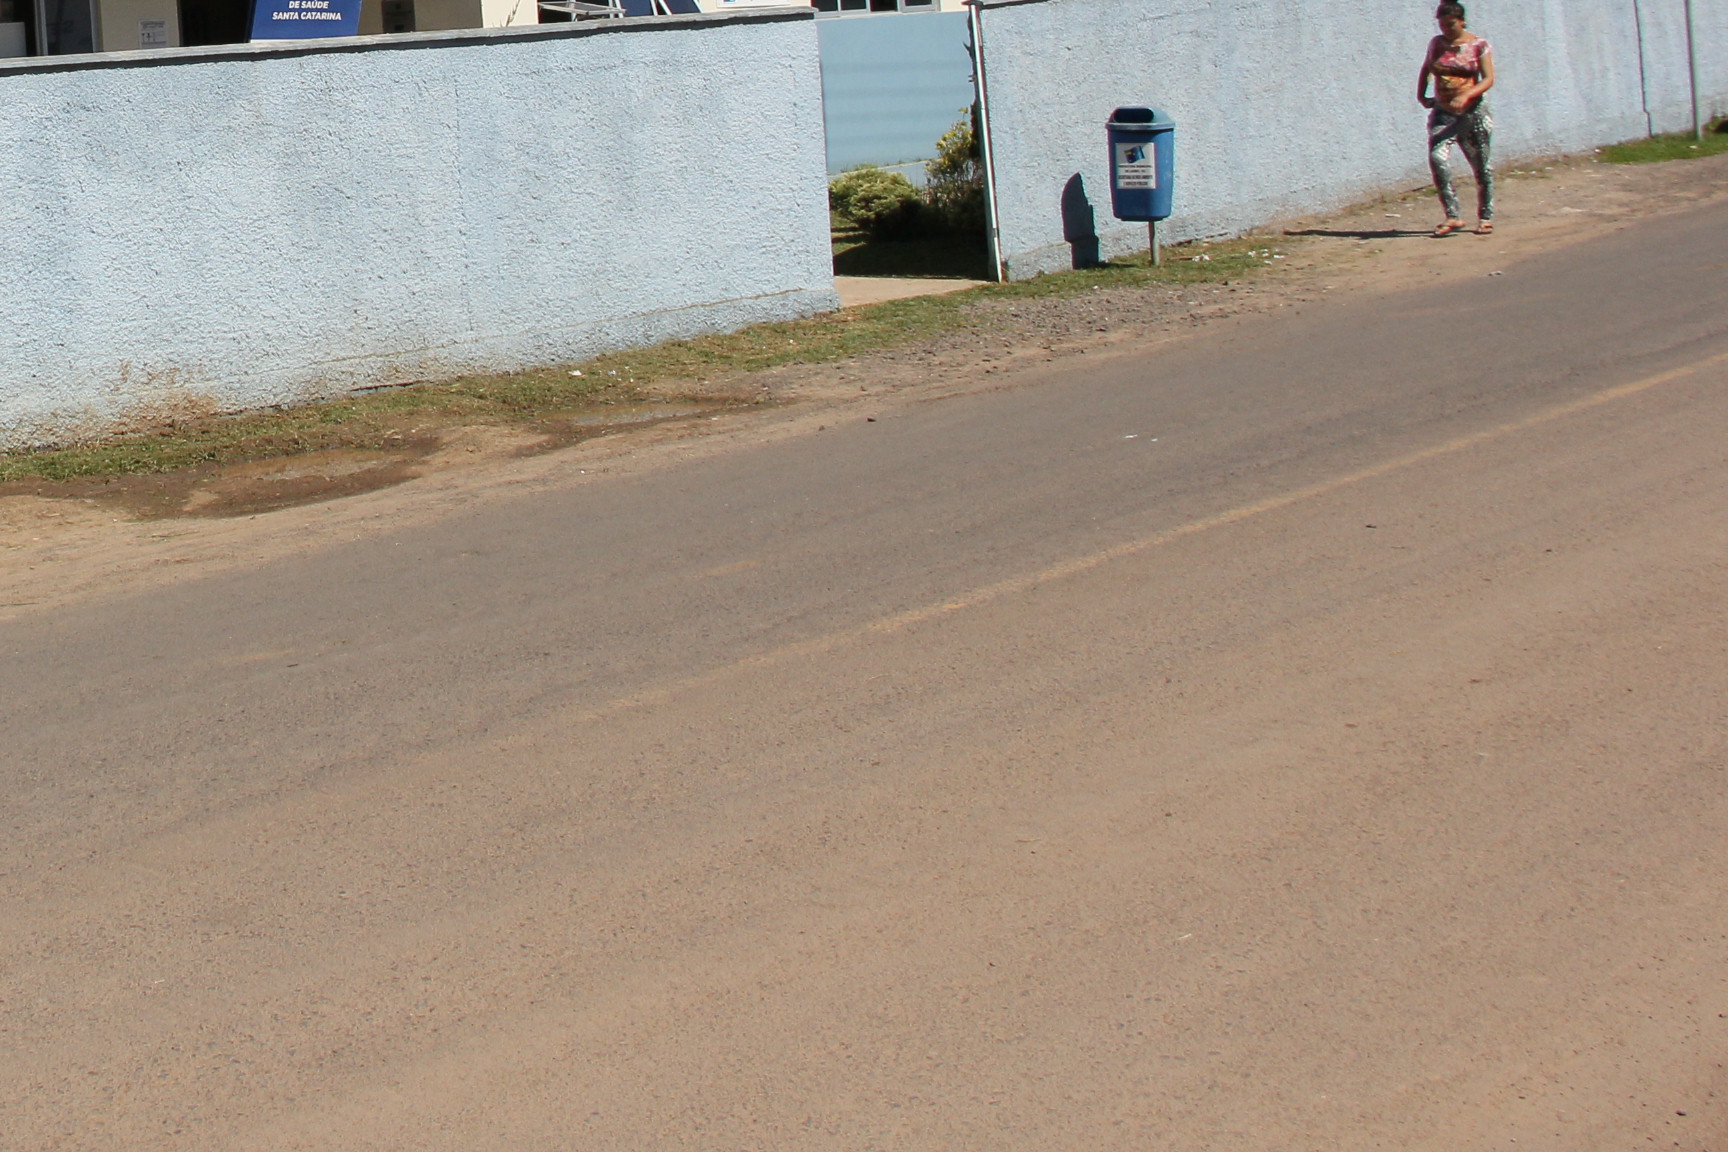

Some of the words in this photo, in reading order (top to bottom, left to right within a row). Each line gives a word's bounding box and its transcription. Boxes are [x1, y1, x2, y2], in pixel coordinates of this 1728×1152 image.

[288, 0, 300, 9] DE
[301, 0, 329, 9] SAÚDE
[272, 11, 300, 20] SANTA
[300, 11, 342, 21] CATARINA
